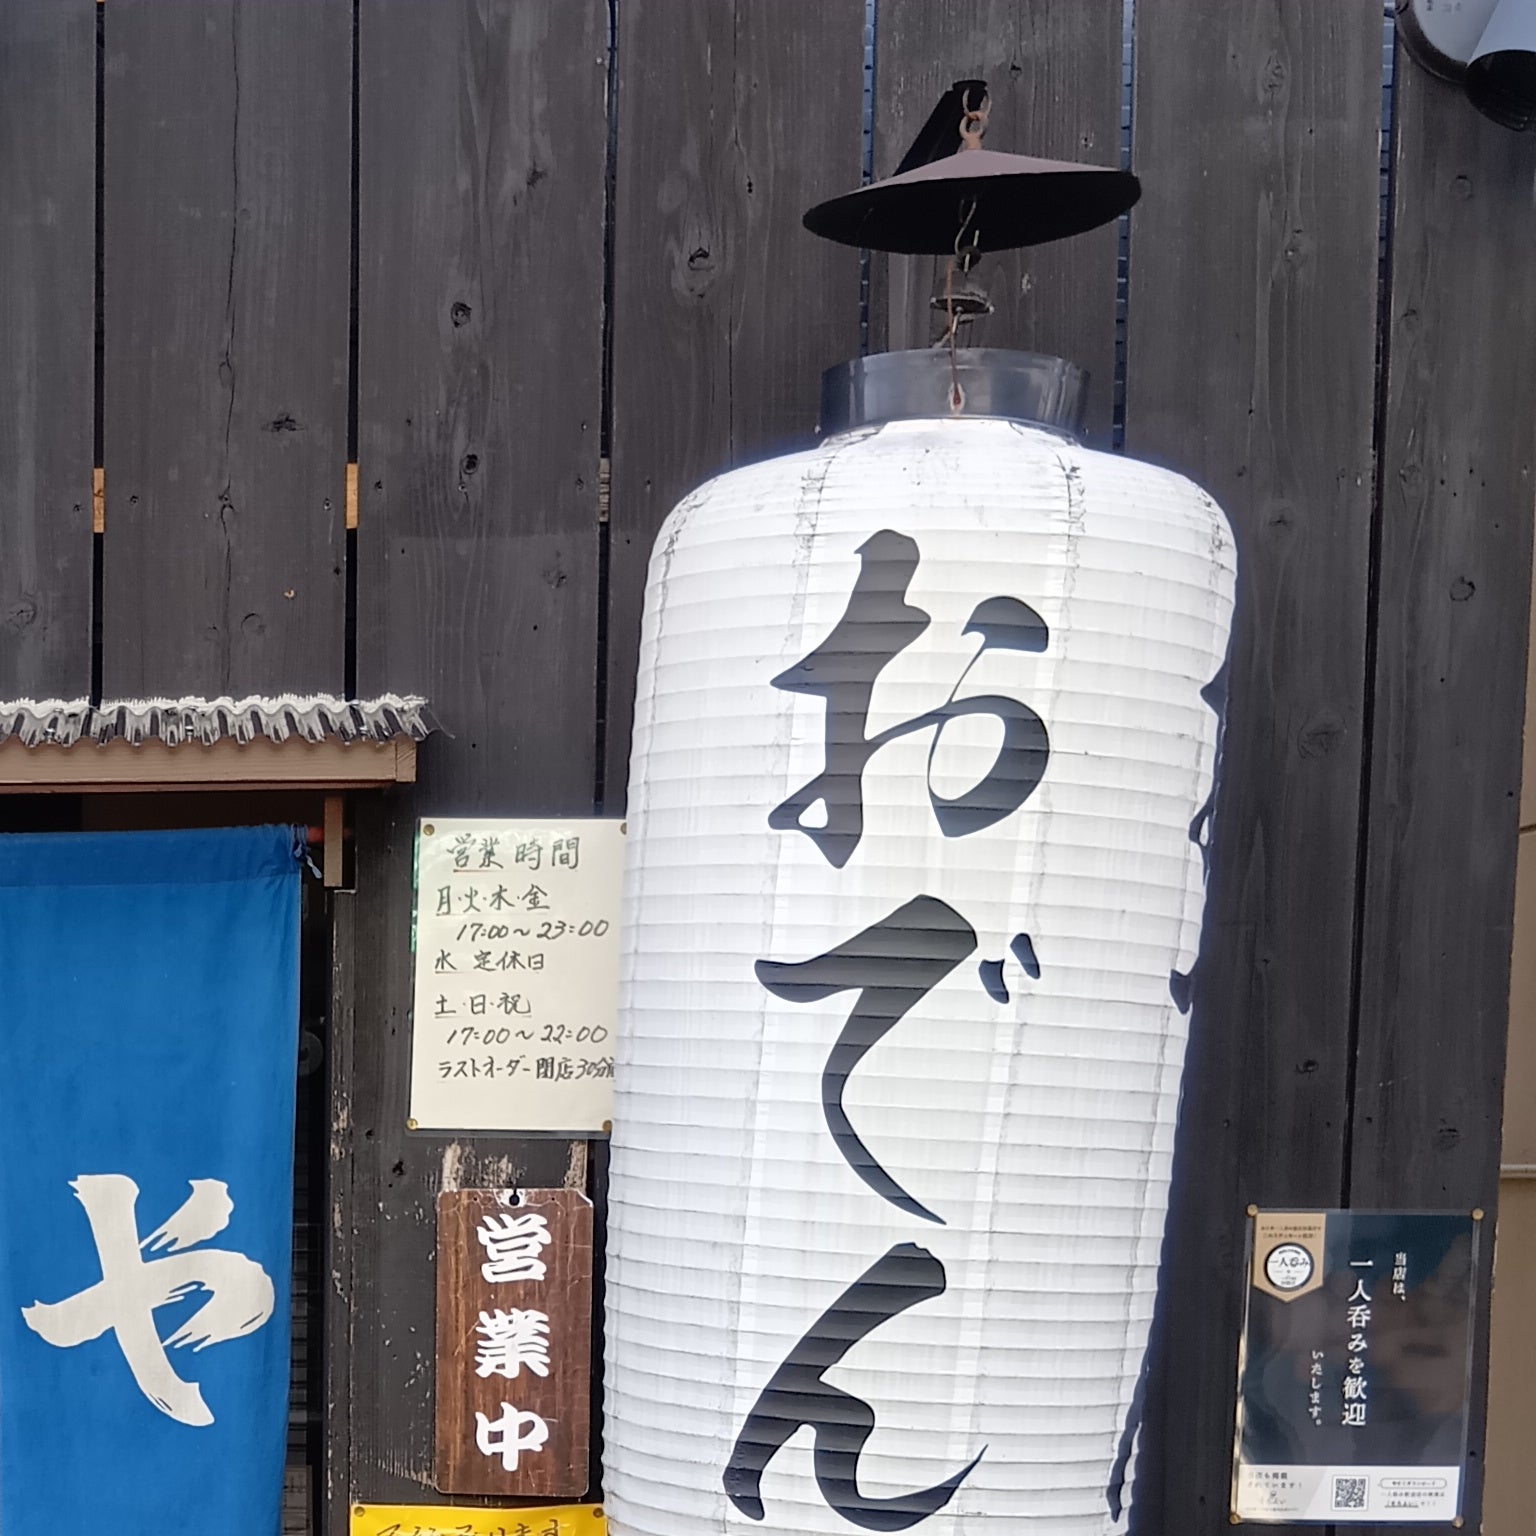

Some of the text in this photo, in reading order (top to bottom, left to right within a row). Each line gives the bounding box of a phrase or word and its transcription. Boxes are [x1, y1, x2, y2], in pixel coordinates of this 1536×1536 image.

[445, 834, 581, 870] 営業時間
[435, 949, 545, 971] 水 定休日
[722, 527, 1050, 1532] おでん
[475, 1213, 552, 1472] 営業中
[1342, 1260, 1374, 1427] 一人呑みを歓迎
